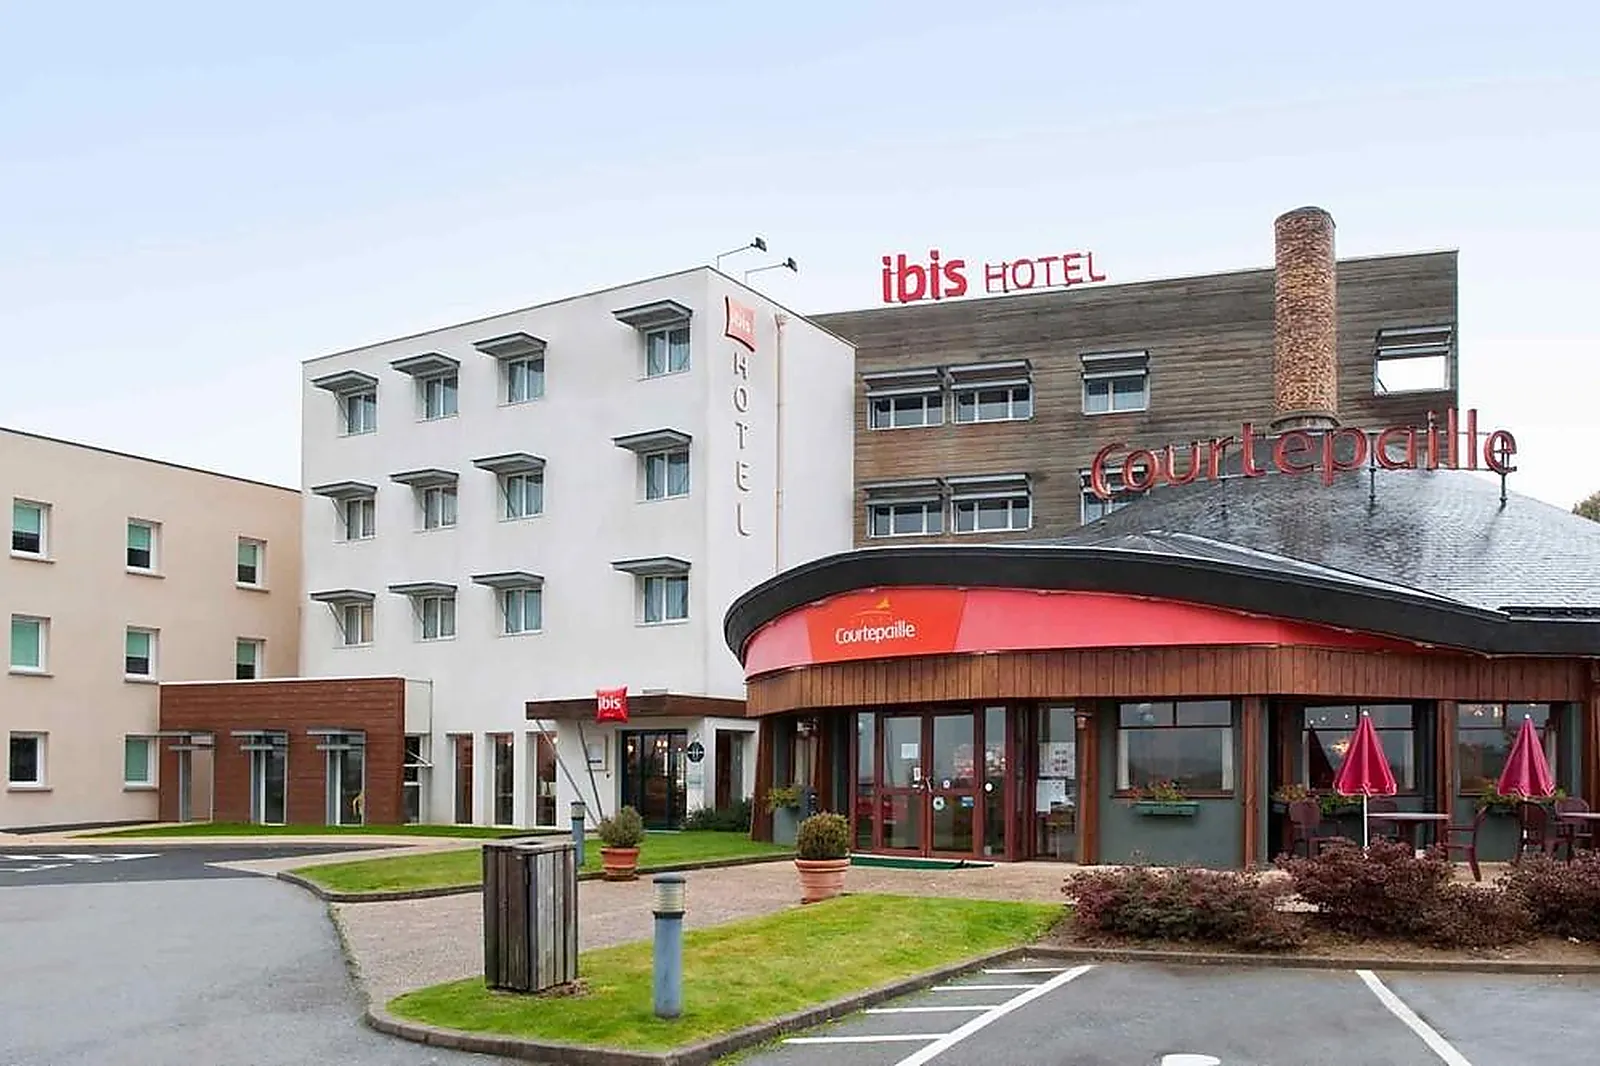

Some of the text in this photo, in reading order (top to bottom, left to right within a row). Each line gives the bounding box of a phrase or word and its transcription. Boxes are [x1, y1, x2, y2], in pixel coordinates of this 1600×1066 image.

[882, 250, 1106, 303] ibis HOTEL
[733, 352, 751, 536] HOTEL
[1091, 406, 1518, 499] Courtepaille
[835, 620, 916, 644] Courtepaille
[598, 695, 621, 710] ibis
